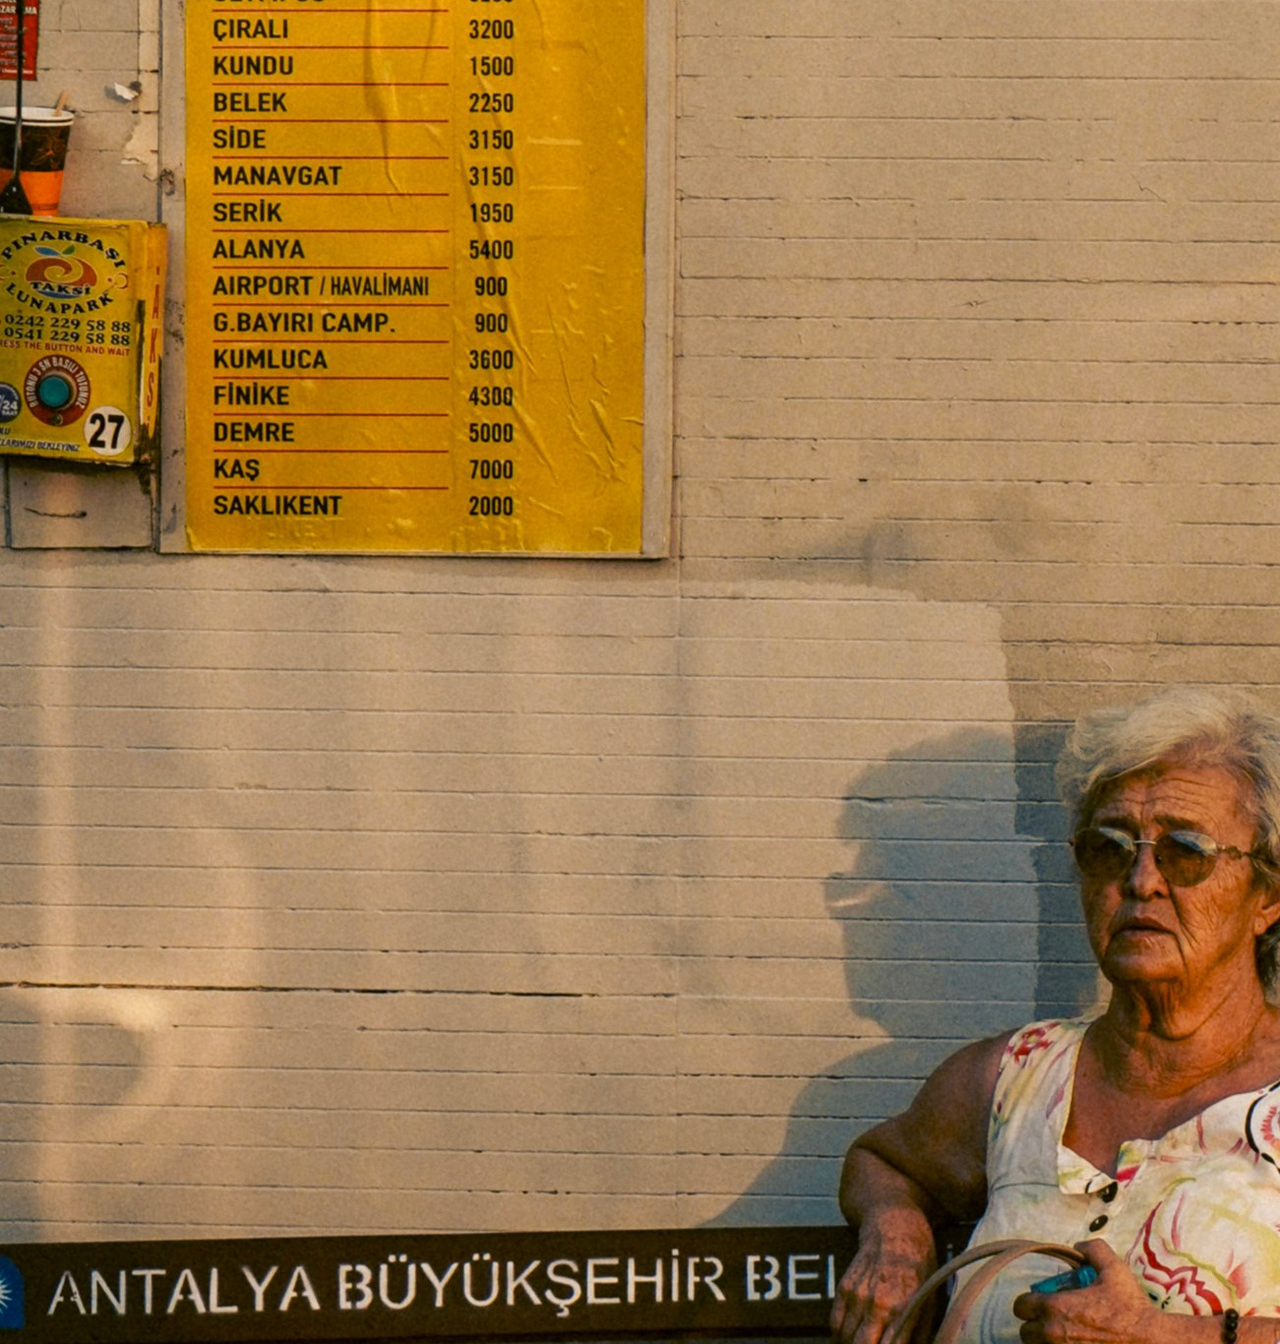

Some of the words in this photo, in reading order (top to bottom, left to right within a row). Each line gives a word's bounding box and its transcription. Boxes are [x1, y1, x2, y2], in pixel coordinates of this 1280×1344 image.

[213, 19, 288, 42] ÇIRALI
[469, 19, 514, 40] 3200
[213, 56, 293, 76] KUNDU
[471, 56, 514, 76] 1500
[213, 93, 287, 113] BELEK
[469, 92, 514, 113] 2250
[213, 125, 266, 149] SİDE
[469, 130, 514, 150] 3150
[213, 166, 342, 186] MANAVGAT
[469, 166, 514, 187] 3150
[213, 198, 283, 223] SERİK
[470, 203, 514, 223] 1950
[2, 230, 126, 268] PINARBAŞI
[213, 239, 305, 259] ALANYA
[469, 239, 514, 260] 5400
[30, 281, 91, 295] TAKSİ
[213, 276, 314, 296] AIRPORT
[330, 273, 429, 296] HAVALİMANI
[474, 276, 508, 297] 900
[6, 282, 114, 314] LUNAPARK
[4, 314, 44, 327] 0242
[51, 317, 81, 330] 229
[86, 319, 106, 332] 58
[111, 321, 131, 333] 88
[213, 312, 314, 333] G.BAYIRI
[322, 312, 396, 333] CAMP.
[475, 312, 509, 334] 900
[4, 327, 43, 340] 0541
[50, 329, 80, 342] 229
[86, 332, 105, 345] 58
[110, 333, 130, 346] 88
[24, 341, 41, 350] THE
[45, 342, 82, 353] BUTTON
[85, 345, 105, 354] AND
[213, 349, 328, 370] KUMLUCA
[469, 349, 514, 370] 3600
[213, 382, 290, 406] FİNİKE
[468, 386, 514, 407] 4300
[89, 413, 124, 449] 27
[213, 422, 295, 443] DEMRE
[469, 422, 514, 443] 5000
[213, 459, 260, 482] KAŞ
[469, 459, 514, 480] 7000
[213, 496, 342, 516] SAKLIKENT
[469, 495, 514, 517] 2000
[47, 1264, 320, 1316] ANTALYA
[338, 1249, 726, 1318] BÜYÜKŞEHİR
